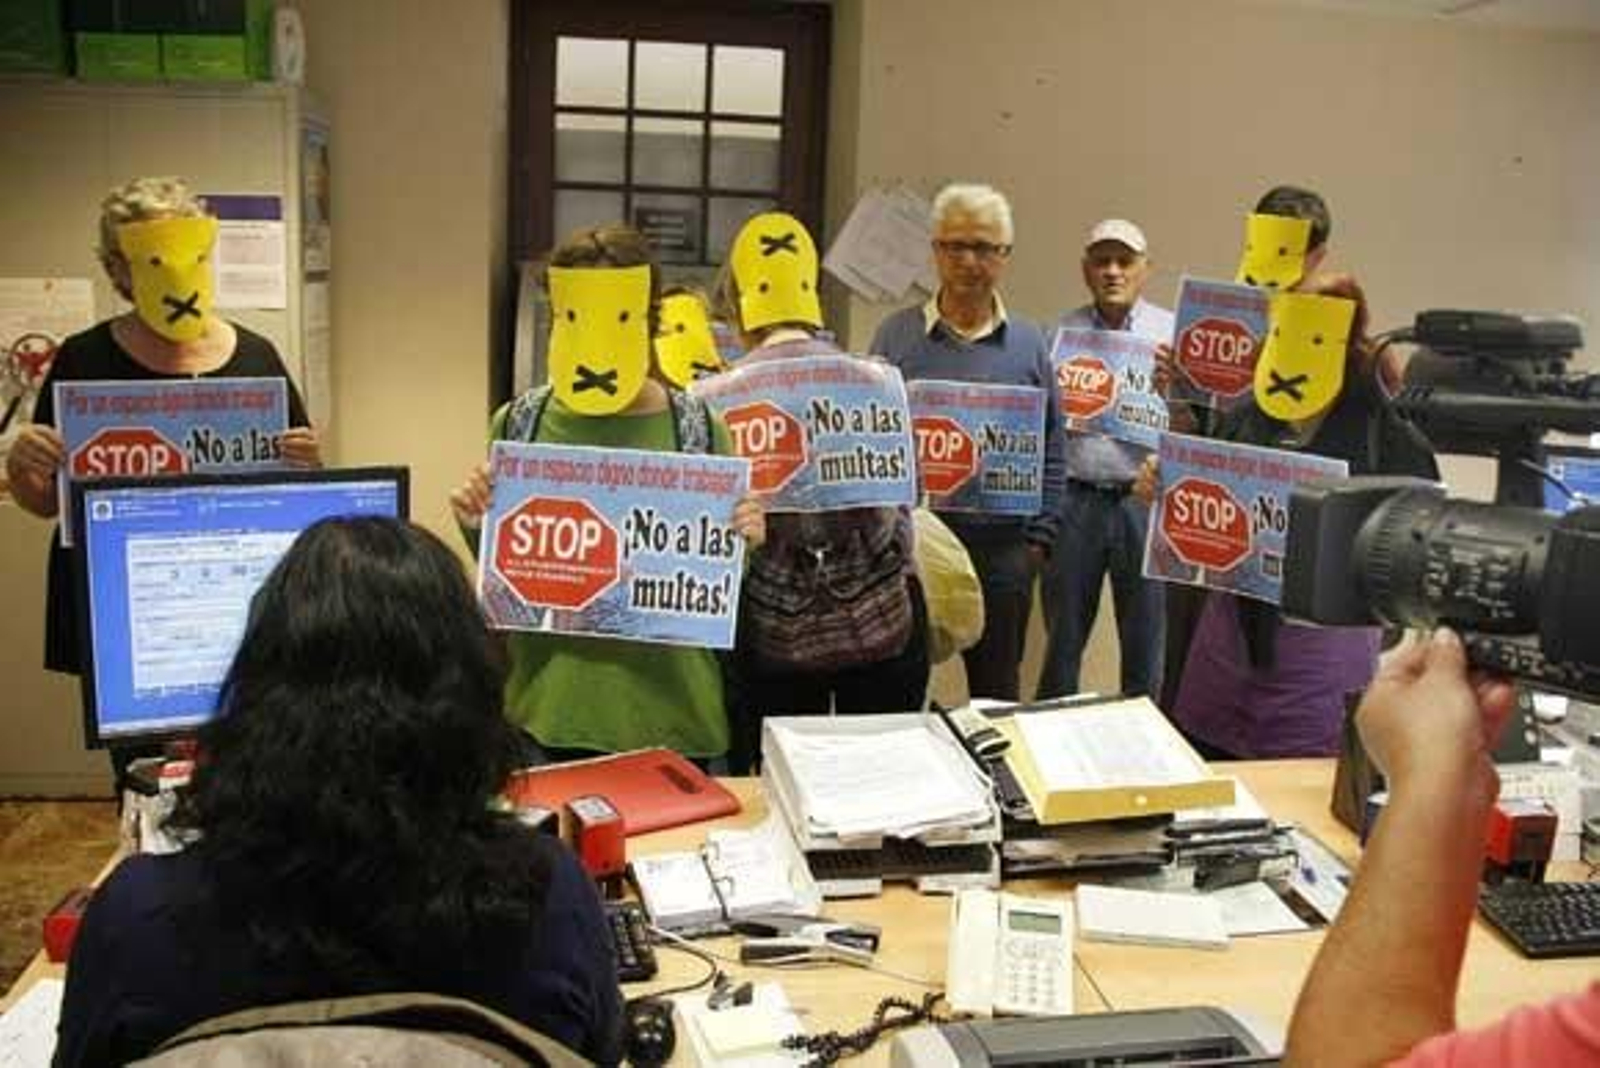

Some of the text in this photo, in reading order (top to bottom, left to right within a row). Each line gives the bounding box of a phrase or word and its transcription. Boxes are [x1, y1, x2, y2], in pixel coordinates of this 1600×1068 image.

[1190, 330, 1251, 364] STOP
[1057, 364, 1110, 391] STOP
[730, 414, 787, 457] TOP
[852, 411, 867, 432] a
[871, 403, 902, 433] las
[87, 444, 170, 476] STOP
[233, 437, 246, 461] a
[914, 427, 964, 459] TOP
[820, 445, 907, 483] multas!
[1173, 488, 1237, 531] STOP
[510, 514, 602, 561] STOP
[624, 508, 737, 558] ¡No a las
[632, 571, 732, 615] multas!
